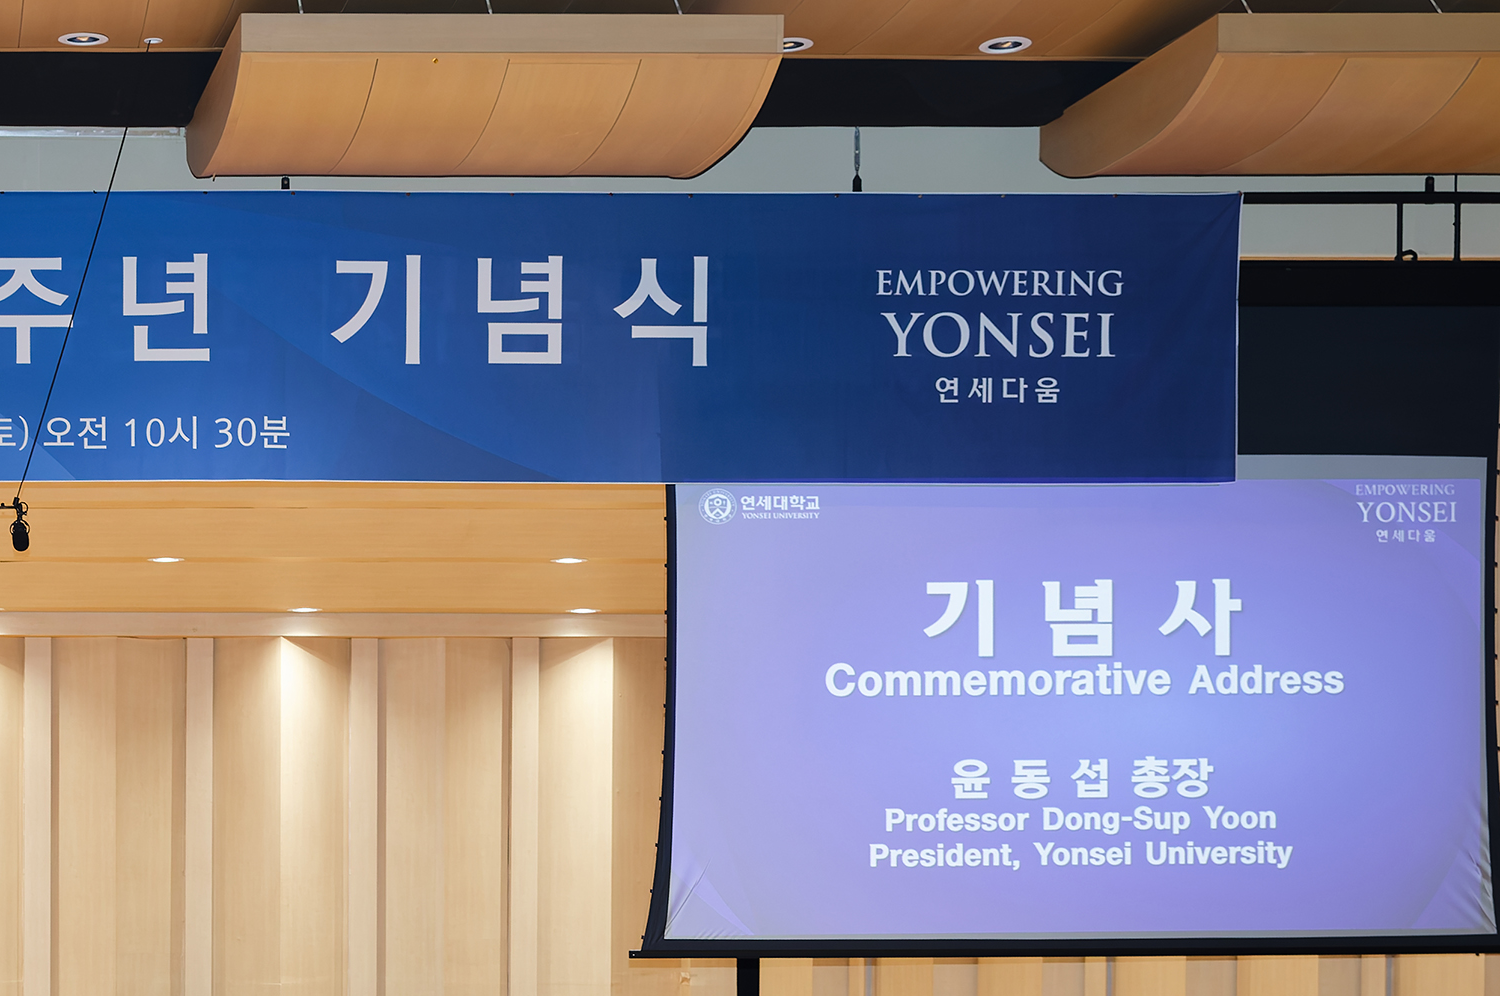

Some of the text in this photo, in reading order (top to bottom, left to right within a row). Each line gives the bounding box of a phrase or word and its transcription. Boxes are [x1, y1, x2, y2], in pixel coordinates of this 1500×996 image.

[876, 269, 1124, 297] EMPOWERING
[330, 254, 709, 367] 기념식
[880, 311, 1116, 358] YONSEI
[935, 377, 1061, 404] 연세다움
[43, 416, 108, 450] 오전
[124, 415, 198, 450] 10시
[214, 415, 291, 449] 30분
[740, 495, 820, 511] 연세대학교
[1355, 483, 1456, 496] EMPOWERING
[1356, 501, 1457, 523] YONSEI
[1376, 529, 1436, 542] 연세다움
[825, 661, 1344, 697] Commemorative Address
[1131, 755, 1214, 799] 총장
[884, 805, 1277, 836] Professor Dong-Sup Yoon
[869, 840, 1294, 871] President, Yonsei University
